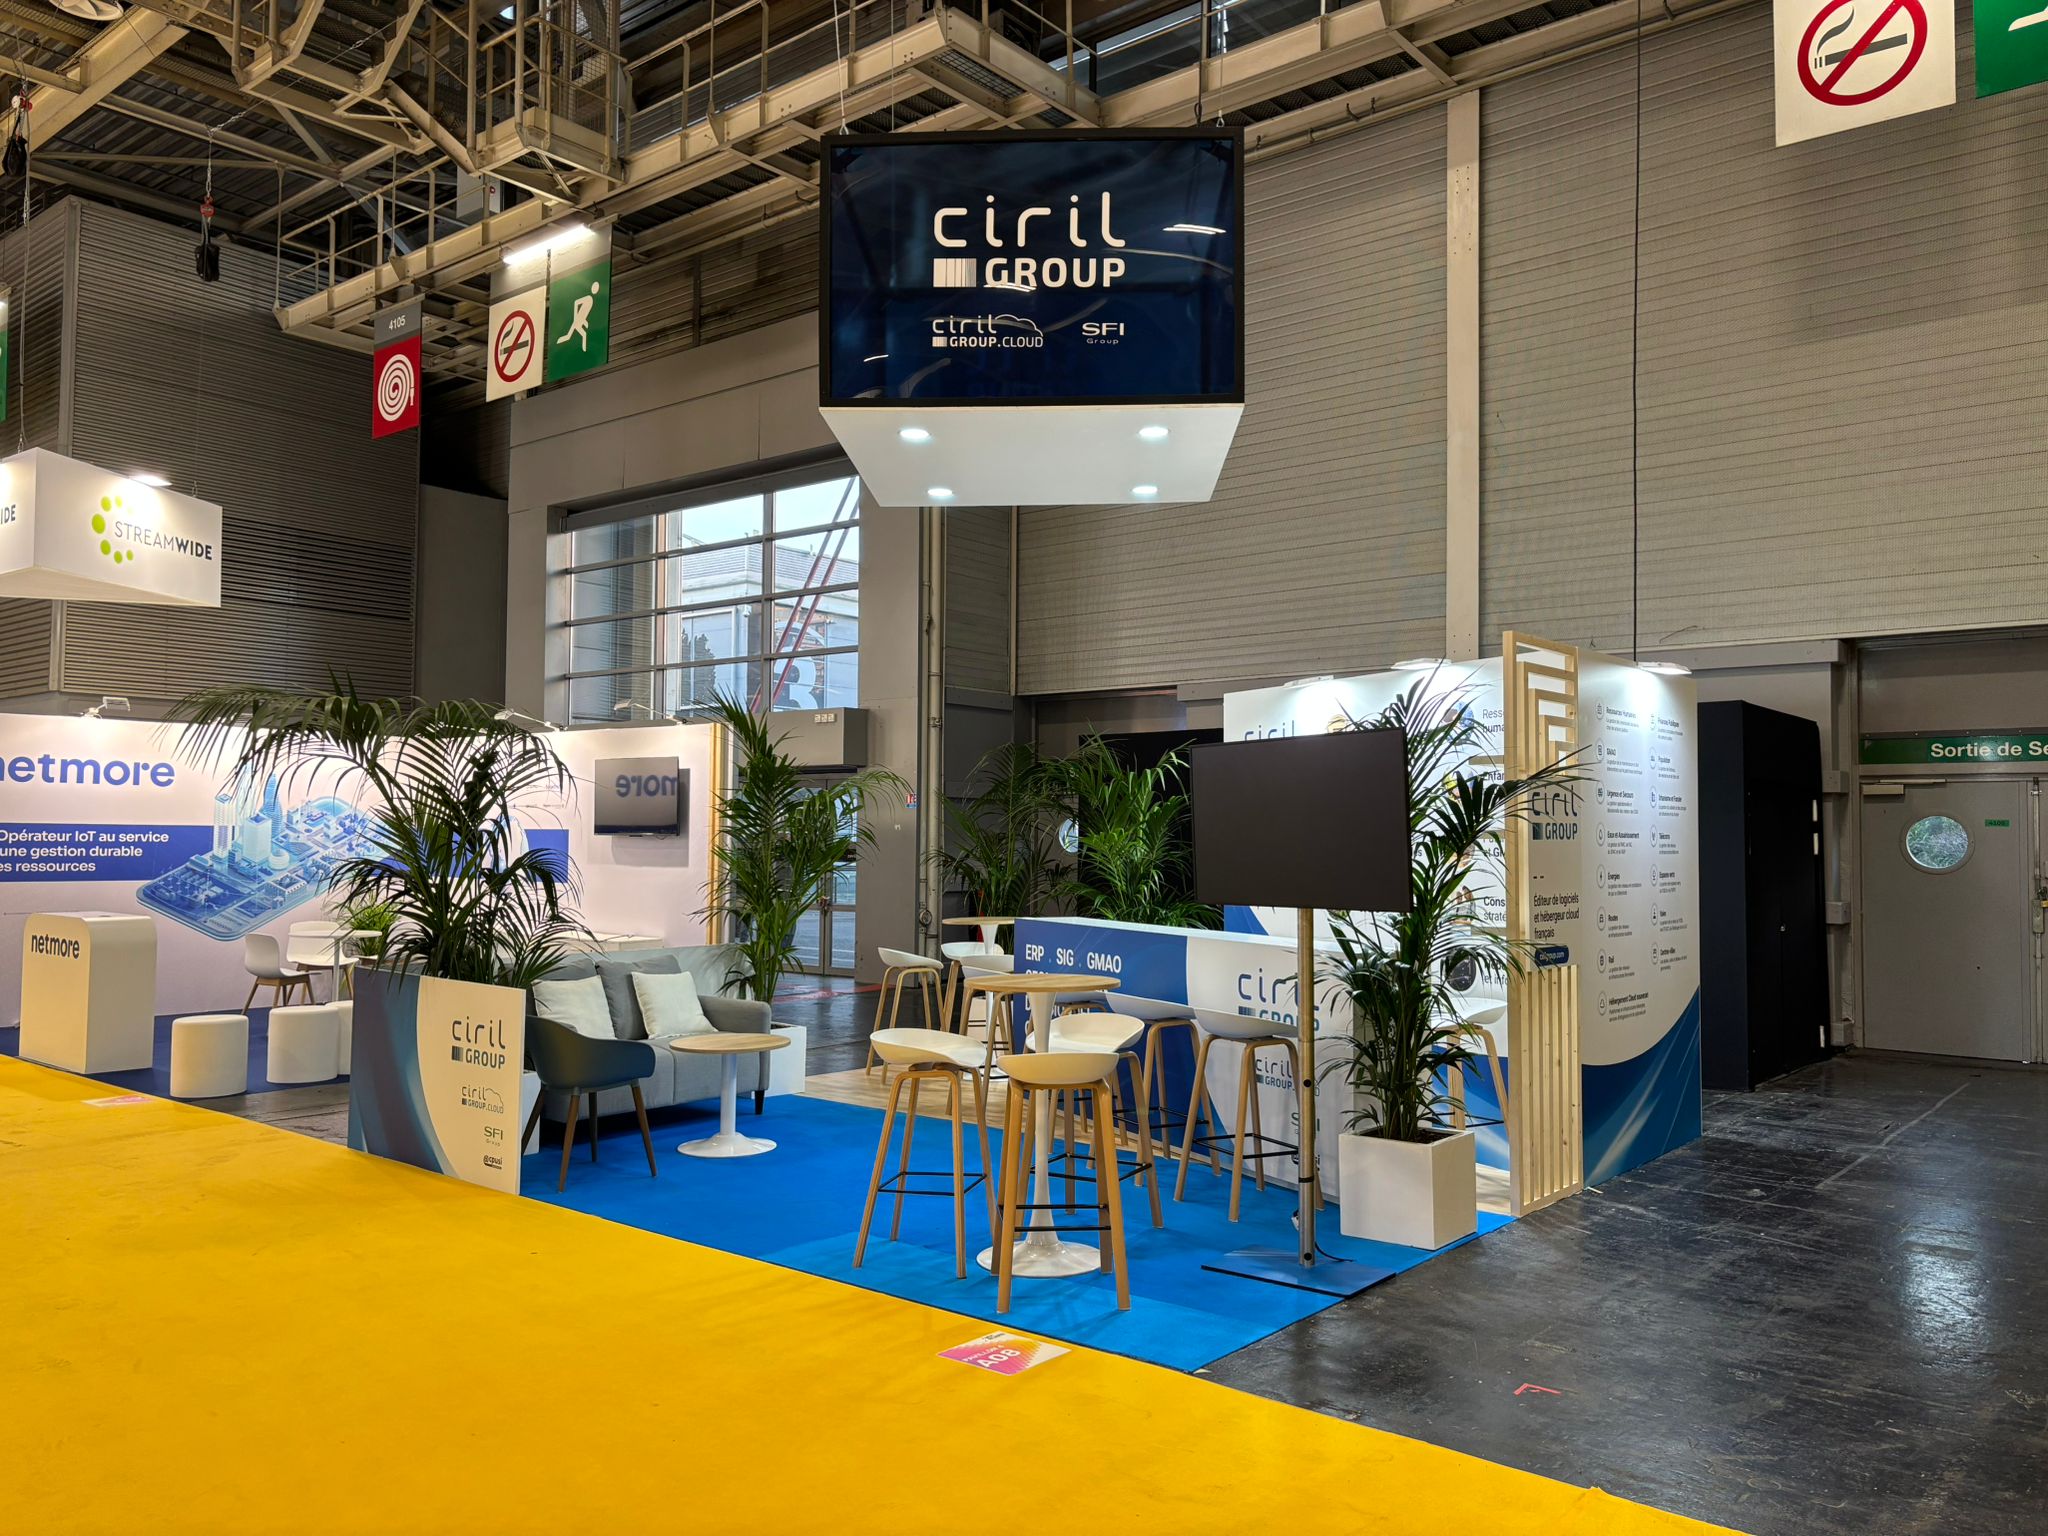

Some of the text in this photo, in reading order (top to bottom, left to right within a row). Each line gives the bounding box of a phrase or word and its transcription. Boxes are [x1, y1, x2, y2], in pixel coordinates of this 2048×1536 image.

[933, 191, 1126, 248] ciril
[985, 257, 1126, 288] GROUP
[932, 314, 997, 334] ciril
[1081, 322, 1125, 336] SFI
[949, 336, 1044, 348] GROUP.CLOUD
[1086, 337, 1119, 345] Group
[114, 520, 213, 560] STREAMWIDE
[1930, 742, 1993, 758] Sortie
[1997, 741, 2023, 757] de
[0, 753, 175, 788] etmore
[1531, 784, 1578, 817] ciril
[0, 829, 169, 844] Opérateur IoT au service
[1545, 822, 1578, 840] GROUP
[30, 845, 86, 859] gestion
[89, 845, 143, 857] durable
[15, 862, 97, 872] ressources
[1566, 907, 1580, 921] cloud
[31, 933, 80, 960] netmore
[1025, 943, 1122, 974] ERP SIG GMAO
[452, 1015, 506, 1050] ciril
[465, 1048, 506, 1070] GROUP
[1256, 1056, 1292, 1079] ciril
[461, 1084, 487, 1101] ciril
[483, 1125, 504, 1141] SFI
